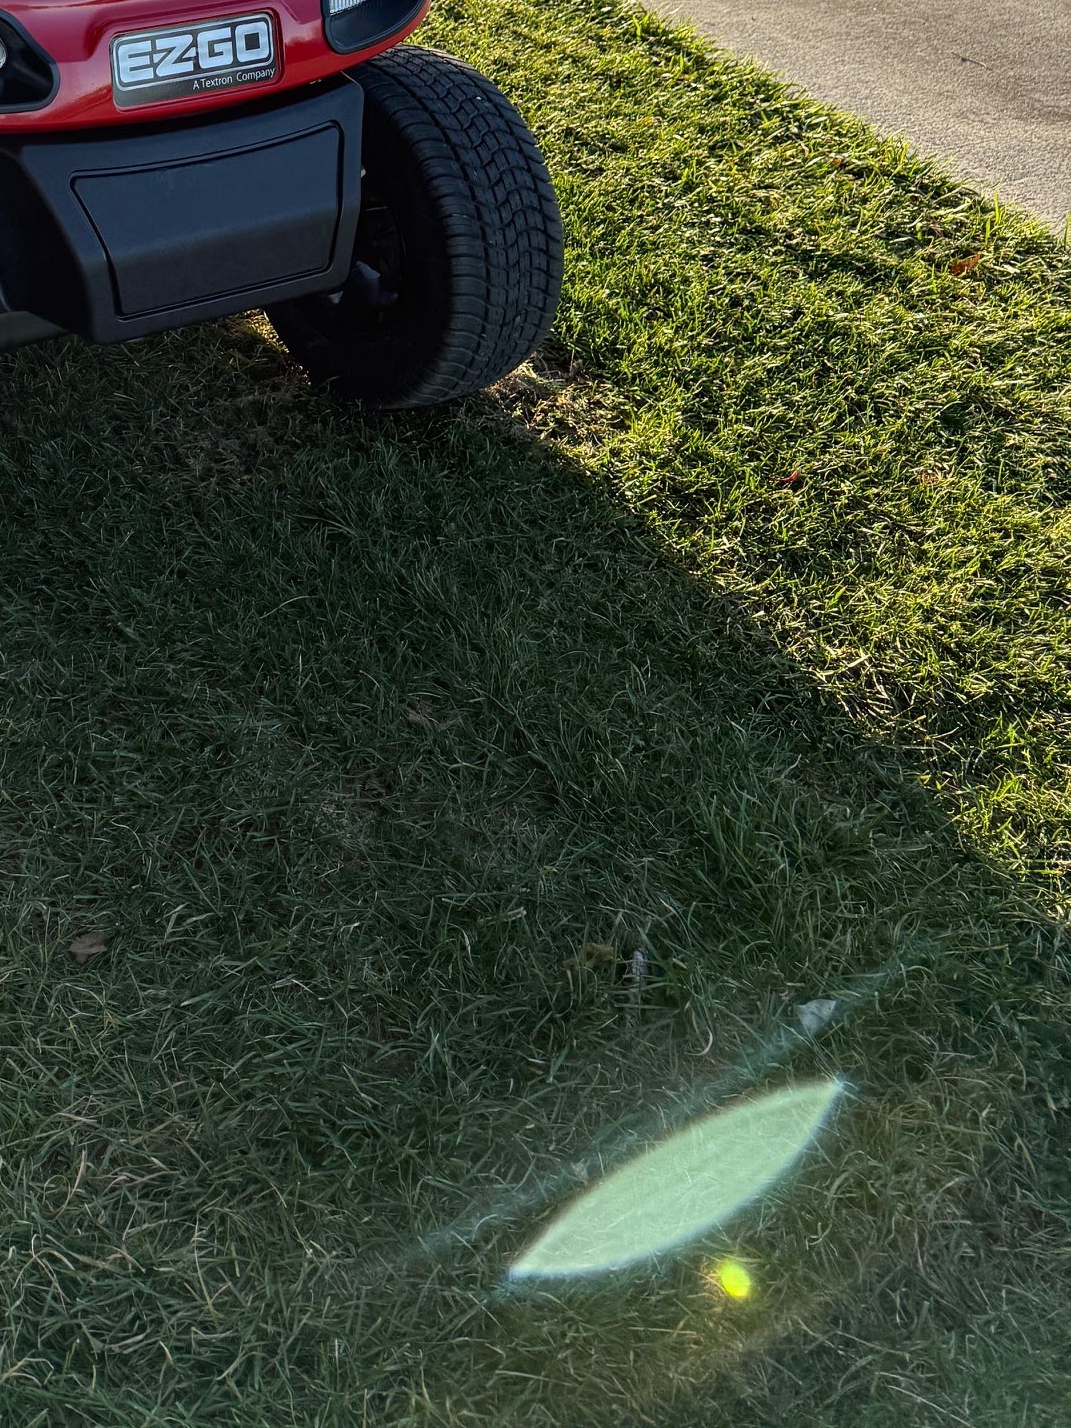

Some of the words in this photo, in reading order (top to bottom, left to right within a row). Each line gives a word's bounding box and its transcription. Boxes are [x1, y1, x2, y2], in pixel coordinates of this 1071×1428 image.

[193, 80, 200, 90] A
[200, 75, 233, 88] Textron
[236, 67, 276, 82] Company
